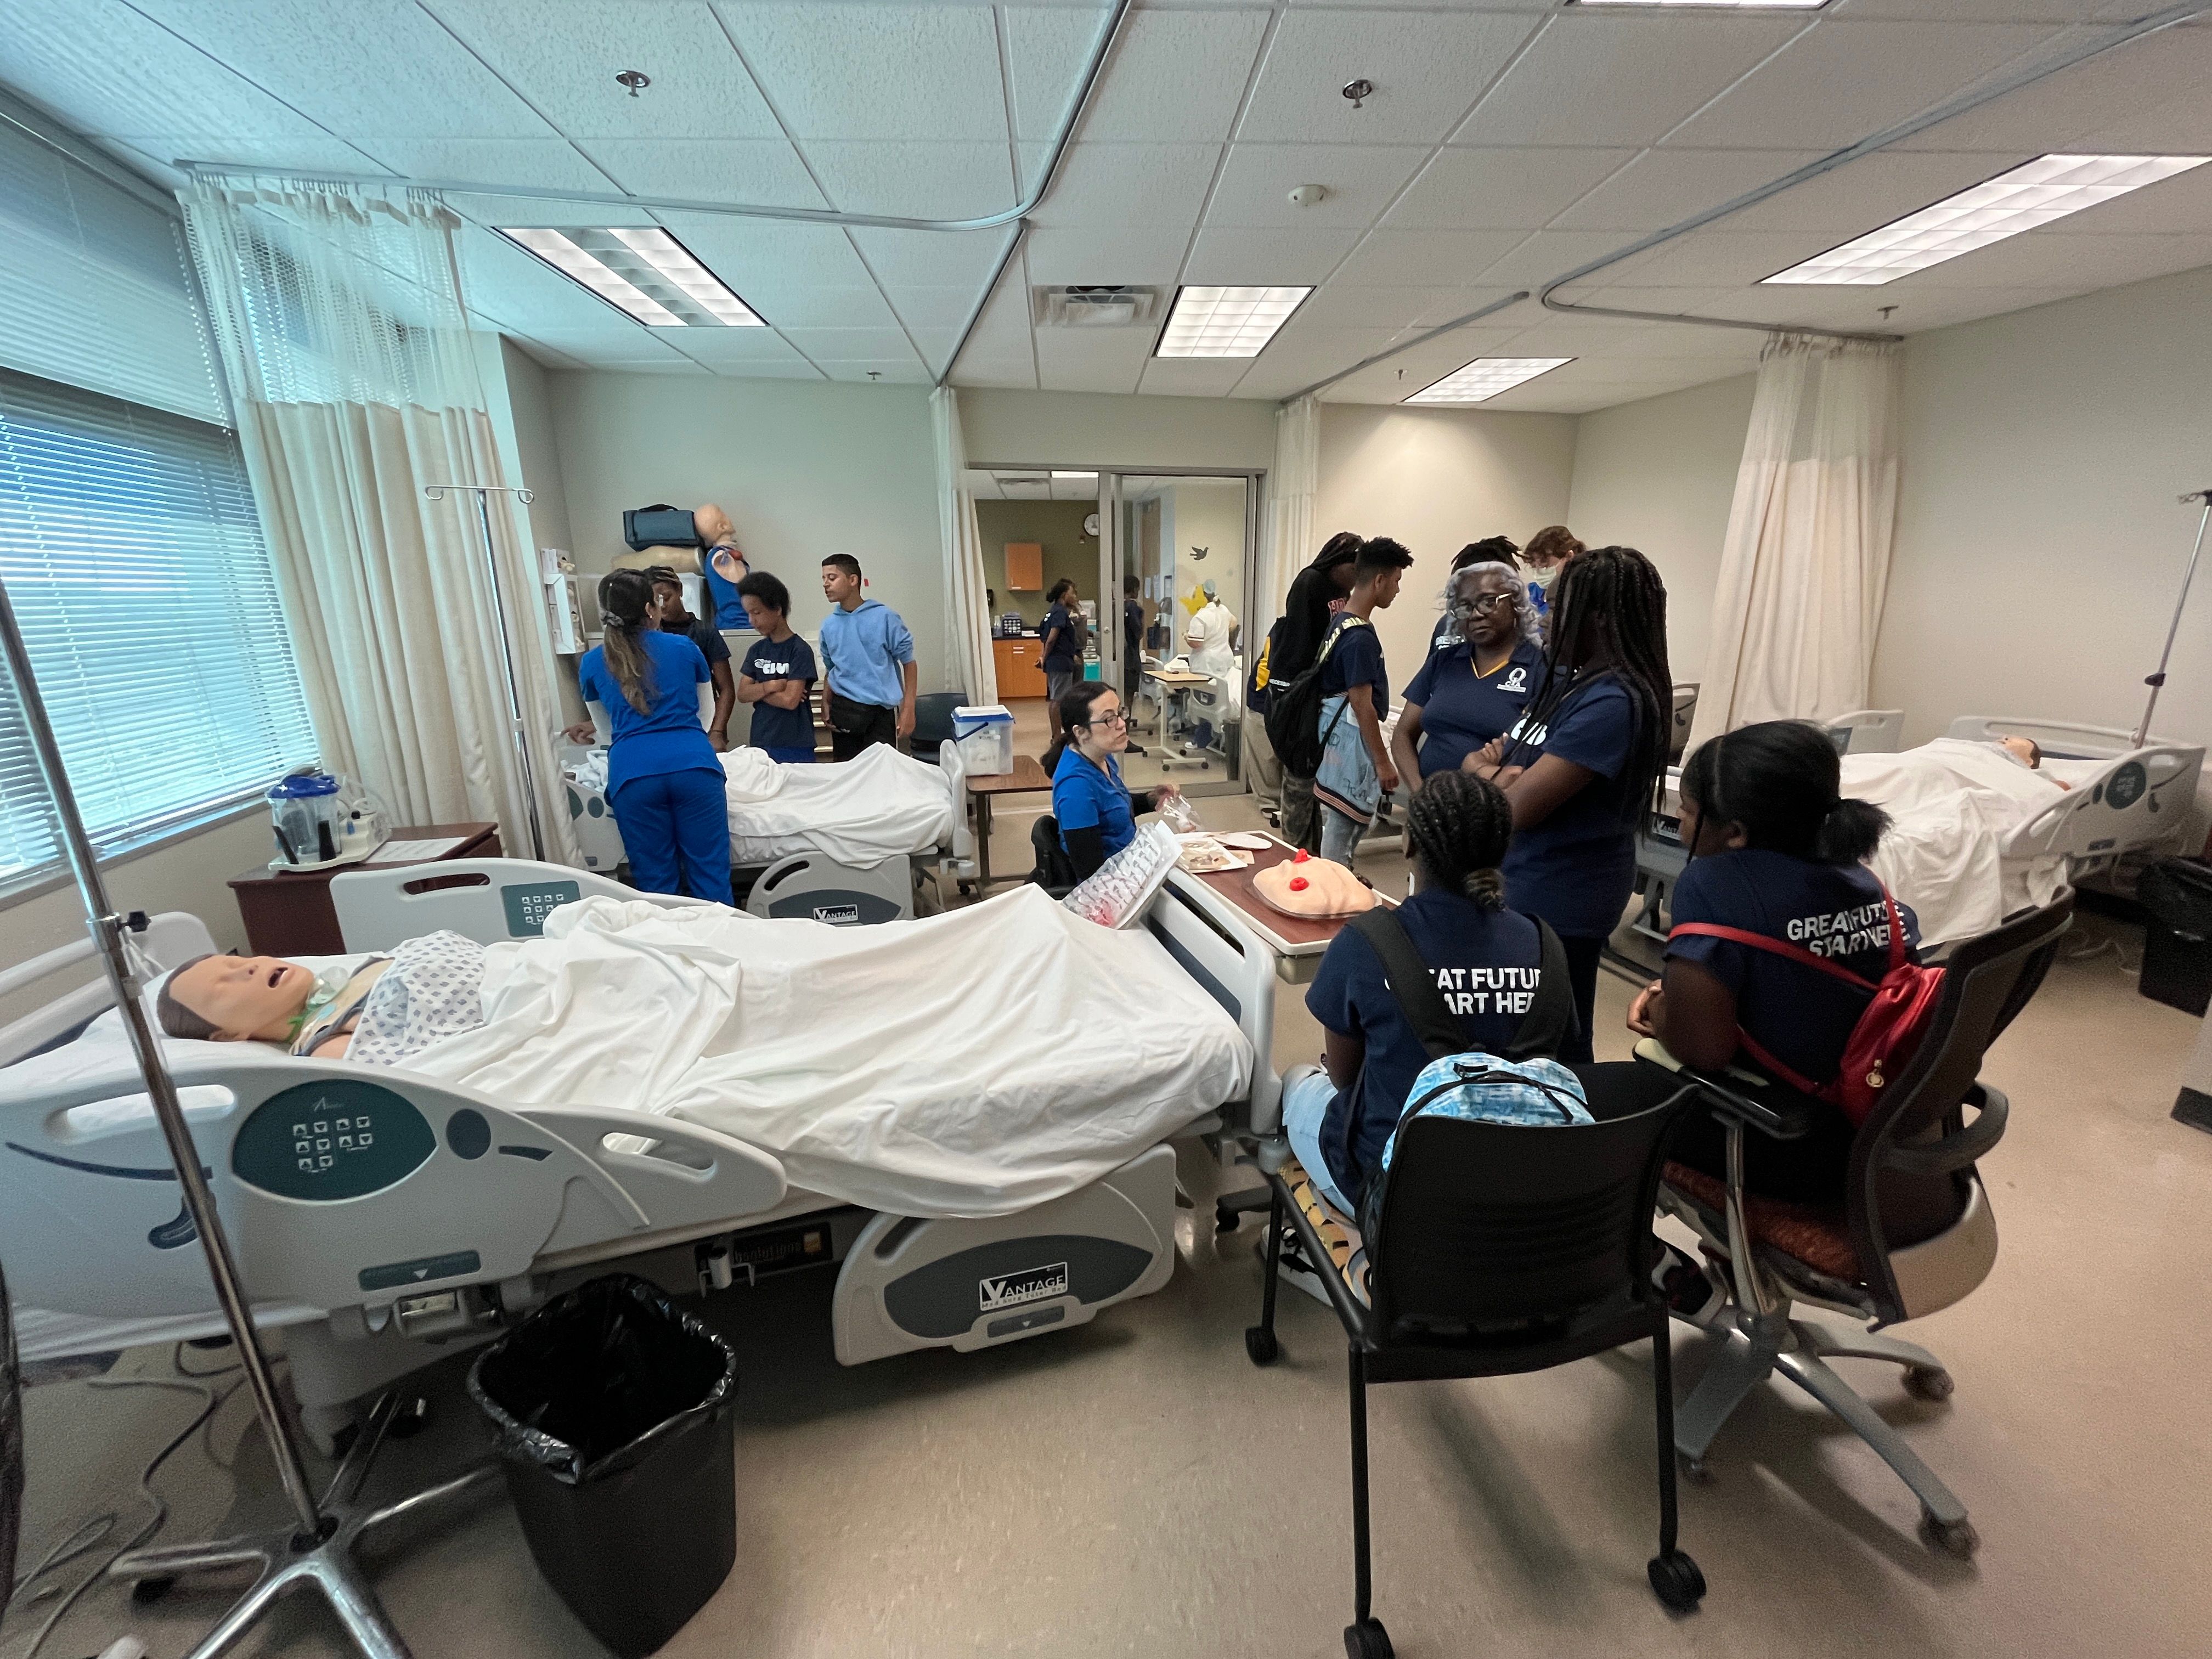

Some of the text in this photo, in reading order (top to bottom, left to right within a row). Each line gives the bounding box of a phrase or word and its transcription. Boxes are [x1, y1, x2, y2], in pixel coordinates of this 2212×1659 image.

[815, 909, 855, 920] VANTAGE
[1471, 967, 1541, 990] FUTU
[982, 1274, 1064, 1302] VANTAGE
